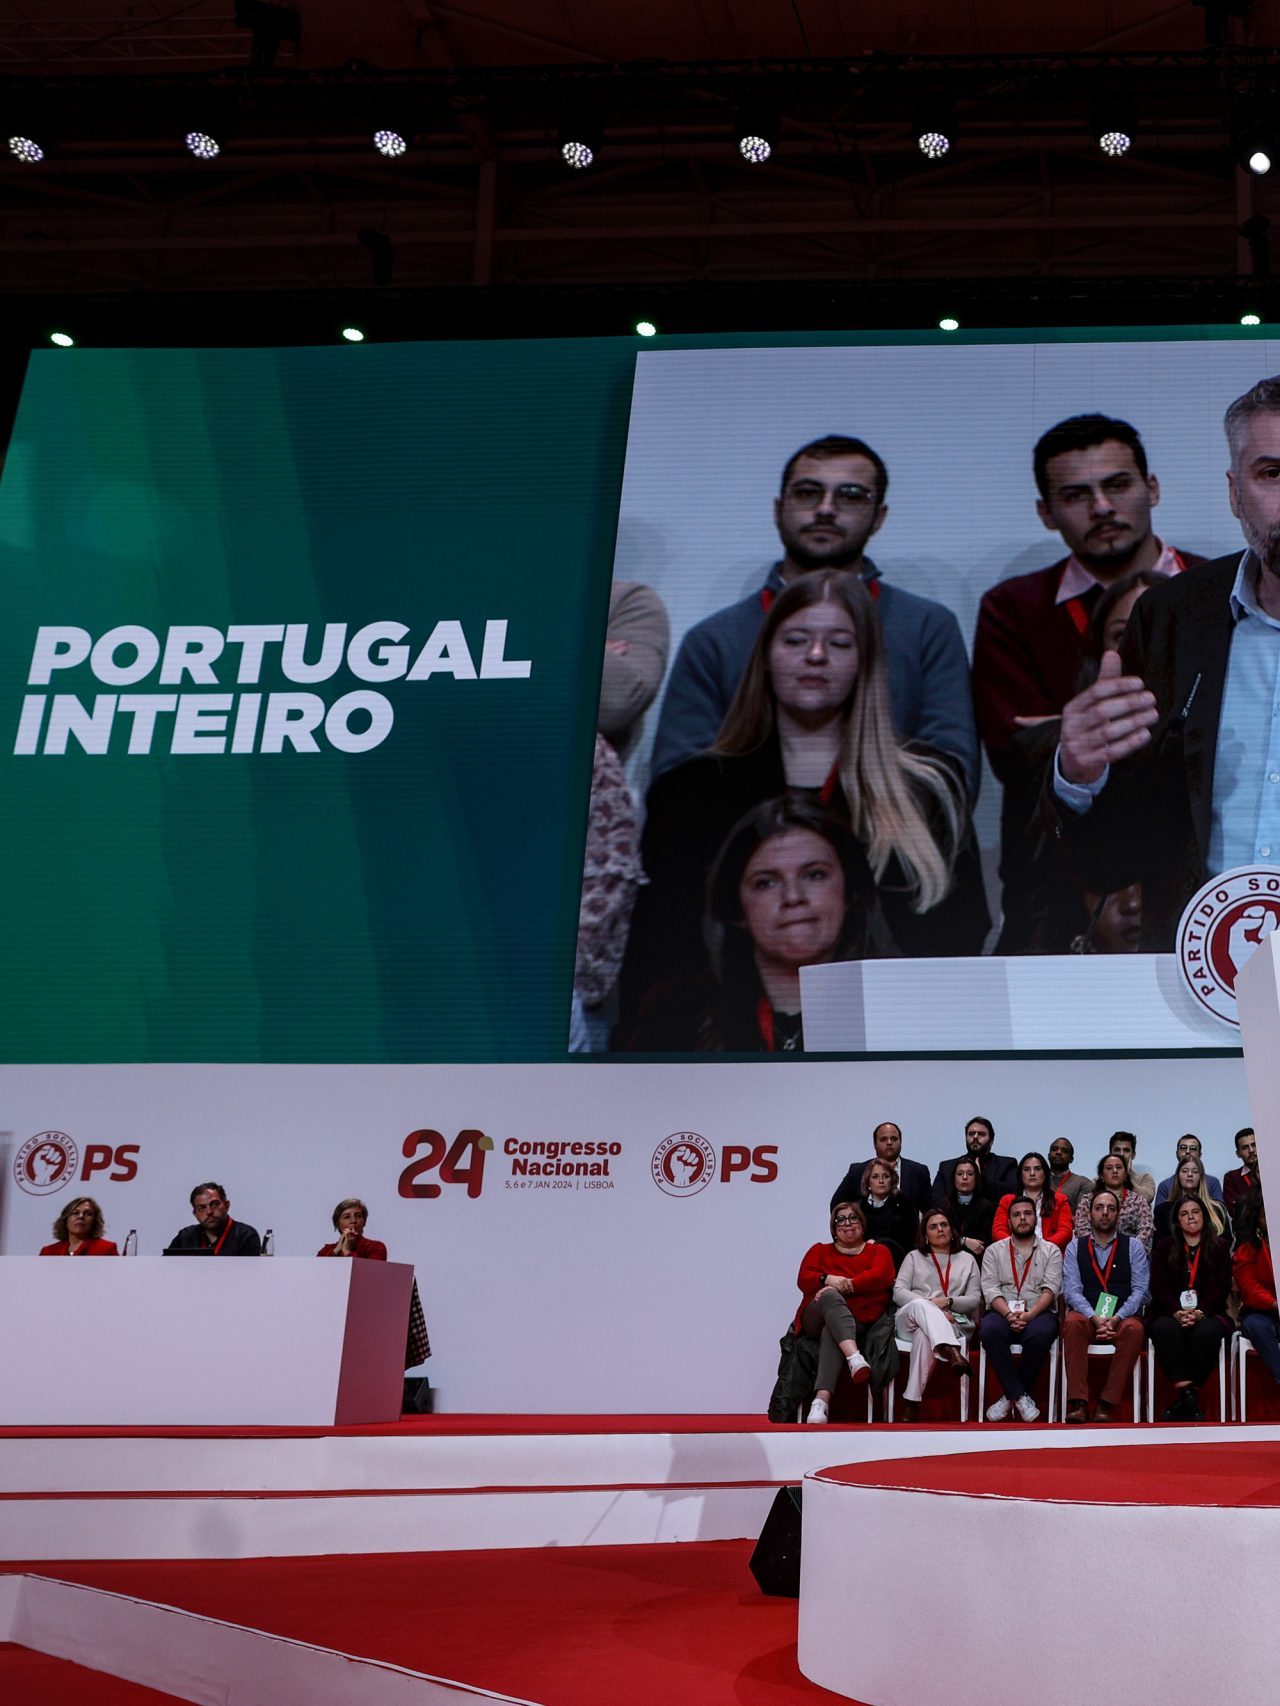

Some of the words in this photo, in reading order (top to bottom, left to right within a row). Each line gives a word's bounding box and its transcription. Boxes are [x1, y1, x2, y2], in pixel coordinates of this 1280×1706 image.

[27, 619, 533, 686] PORTUGAL
[13, 689, 394, 755] INTEIRO
[1188, 889, 1229, 997] PARTIDO
[16, 1138, 39, 1183] PARTIDO
[46, 1133, 75, 1182] SOCIALISTA
[80, 1144, 141, 1182] PS
[397, 1128, 488, 1199] 24
[503, 1137, 622, 1160] Congresso
[511, 1158, 610, 1176] Nacional
[653, 1138, 673, 1184] PARTIDO
[680, 1134, 714, 1184] SOCIALISTA
[720, 1144, 779, 1183] PS
[505, 1180, 512, 1190] 5,
[513, 1180, 519, 1189] 6
[527, 1180, 533, 1189] 7
[533, 1180, 550, 1189] JAN
[552, 1180, 573, 1189] 2024
[583, 1180, 615, 1189] LISBOA
